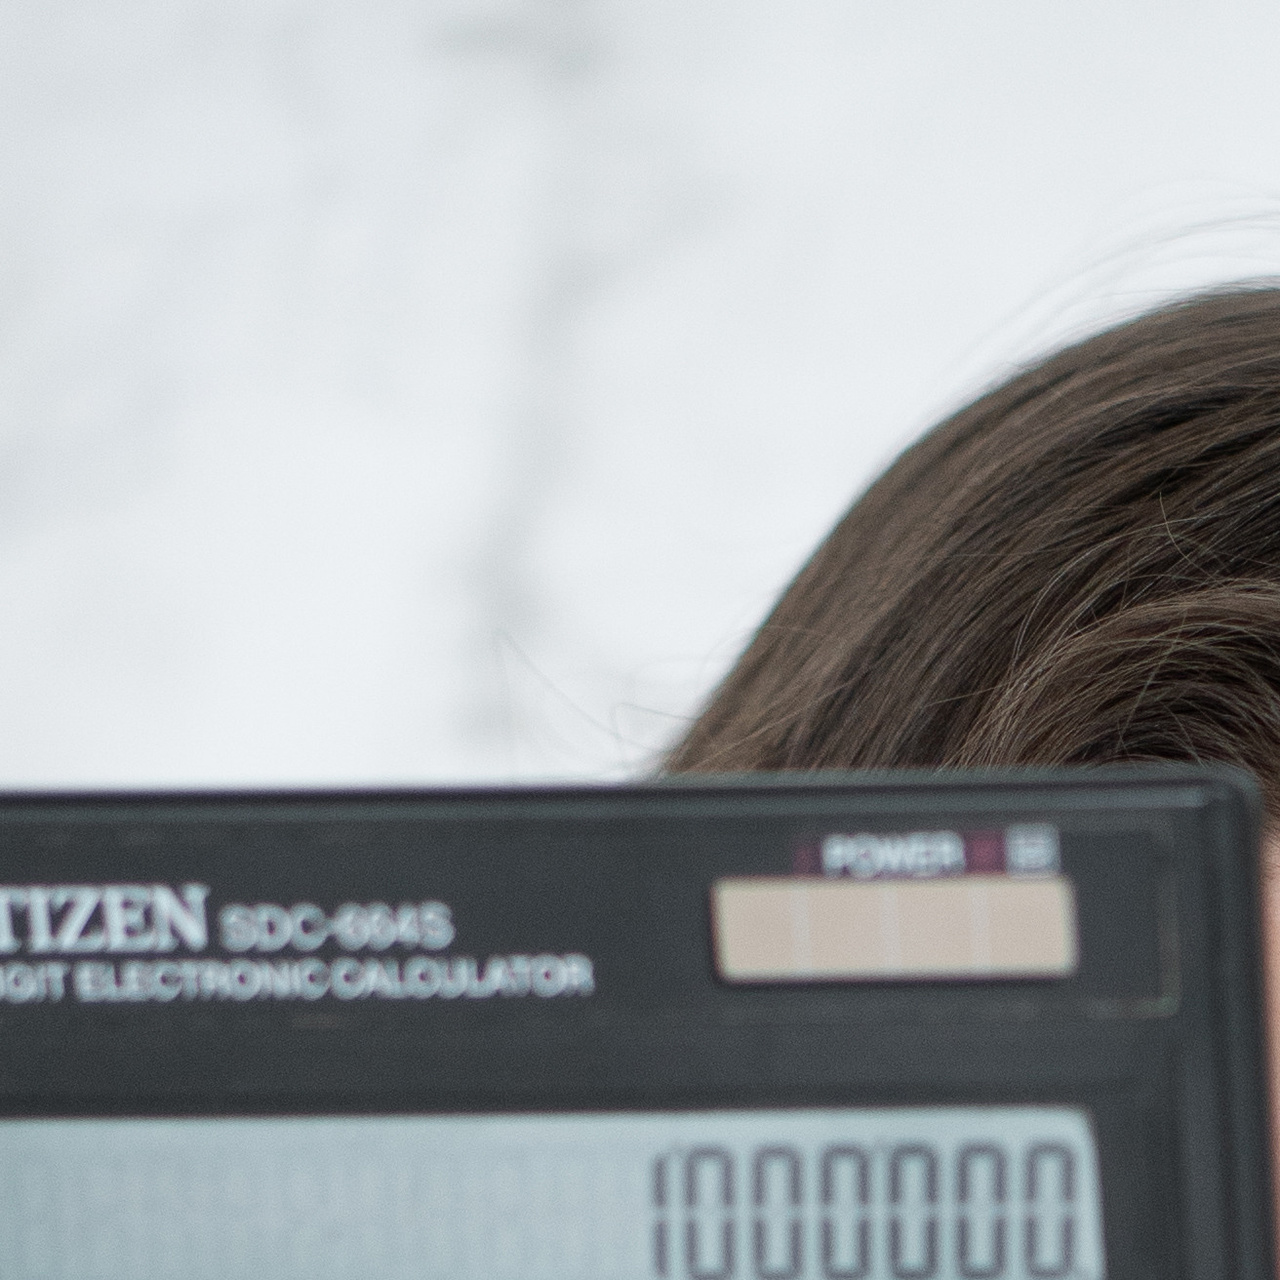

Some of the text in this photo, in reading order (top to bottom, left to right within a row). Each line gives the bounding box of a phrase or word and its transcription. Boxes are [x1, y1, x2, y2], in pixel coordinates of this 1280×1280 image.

[822, 831, 966, 876] POWER
[0, 954, 595, 1002] GIT ELECTRONIC CALCULATOR
[653, 1141, 1074, 1280] 1000000
